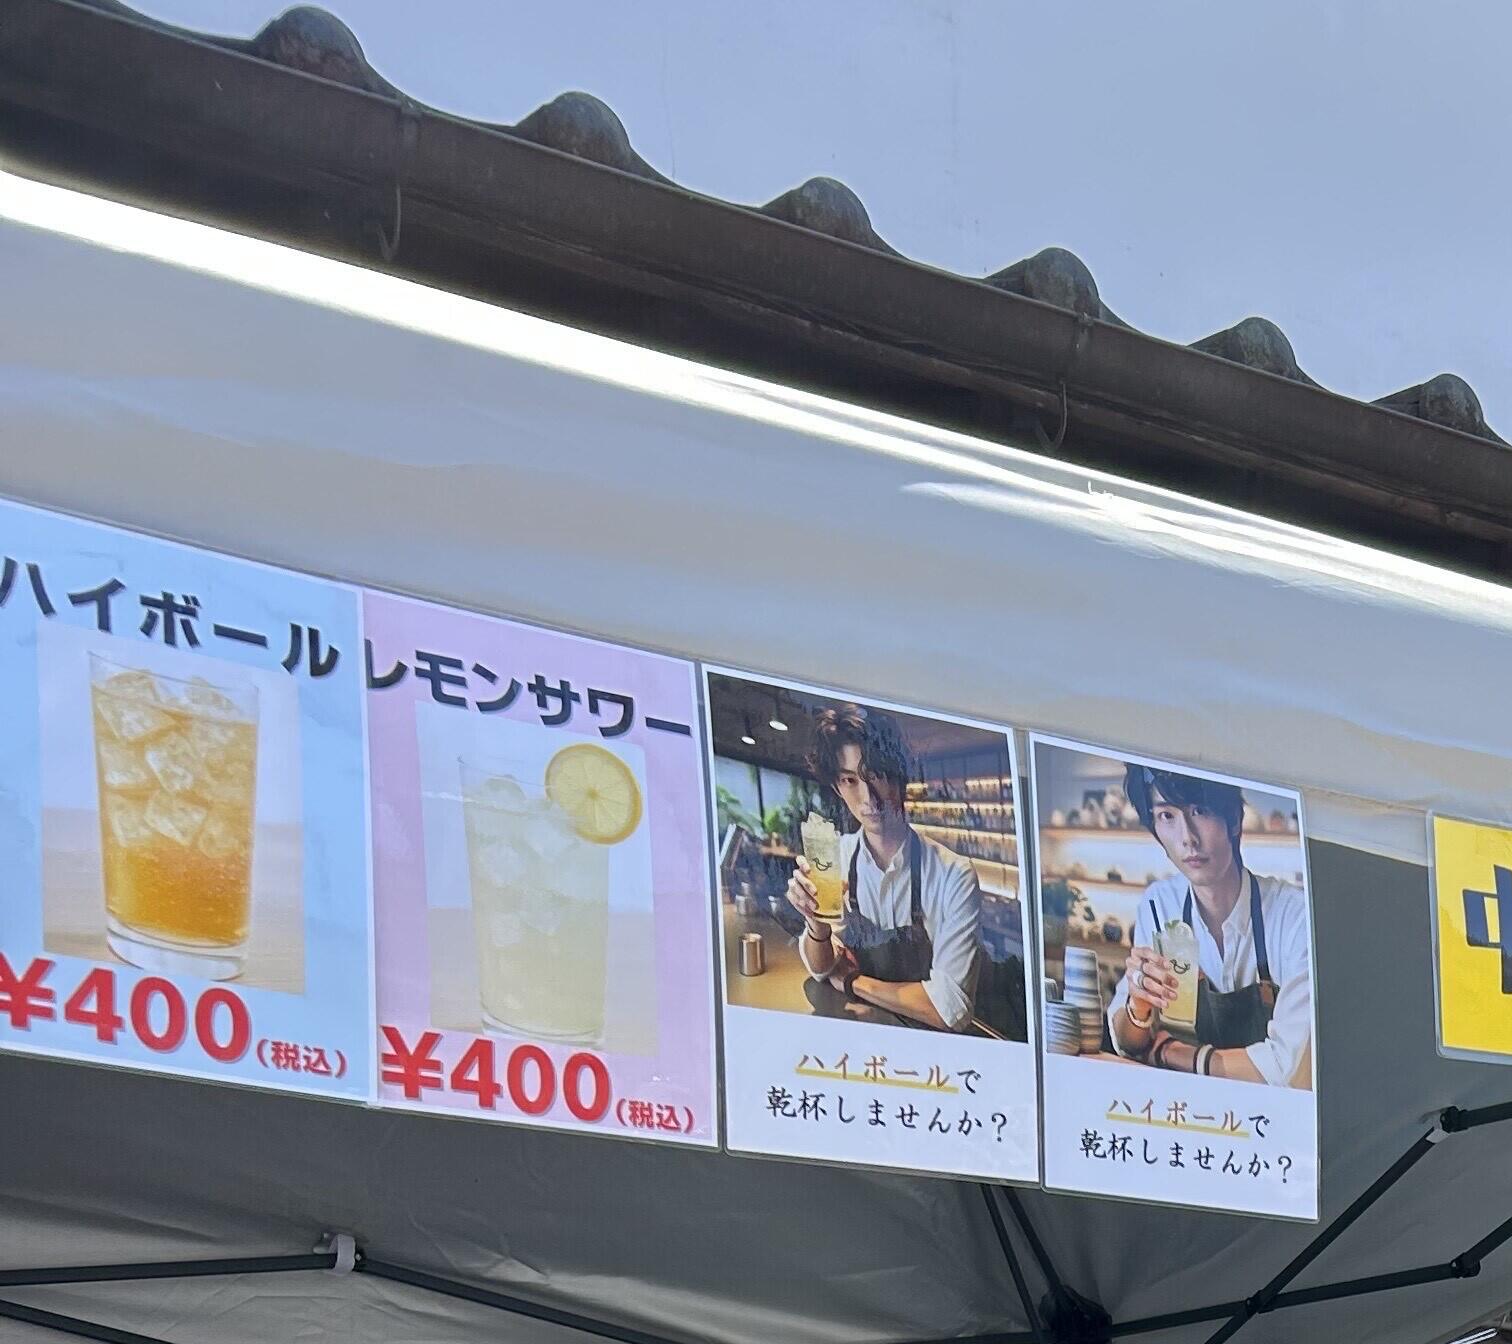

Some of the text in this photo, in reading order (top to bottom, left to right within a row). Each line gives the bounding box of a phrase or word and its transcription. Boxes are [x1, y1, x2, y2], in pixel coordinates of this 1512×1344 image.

[0, 556, 340, 679] ハイボール
[364, 638, 692, 738] レモンサワー
[796, 1052, 983, 1094] ハイボールで
[766, 1086, 1008, 1142] 乾杯しませんか？
[1107, 1097, 1270, 1138] ハイボールで
[1080, 1129, 1293, 1185] 乾杯しませんか？
